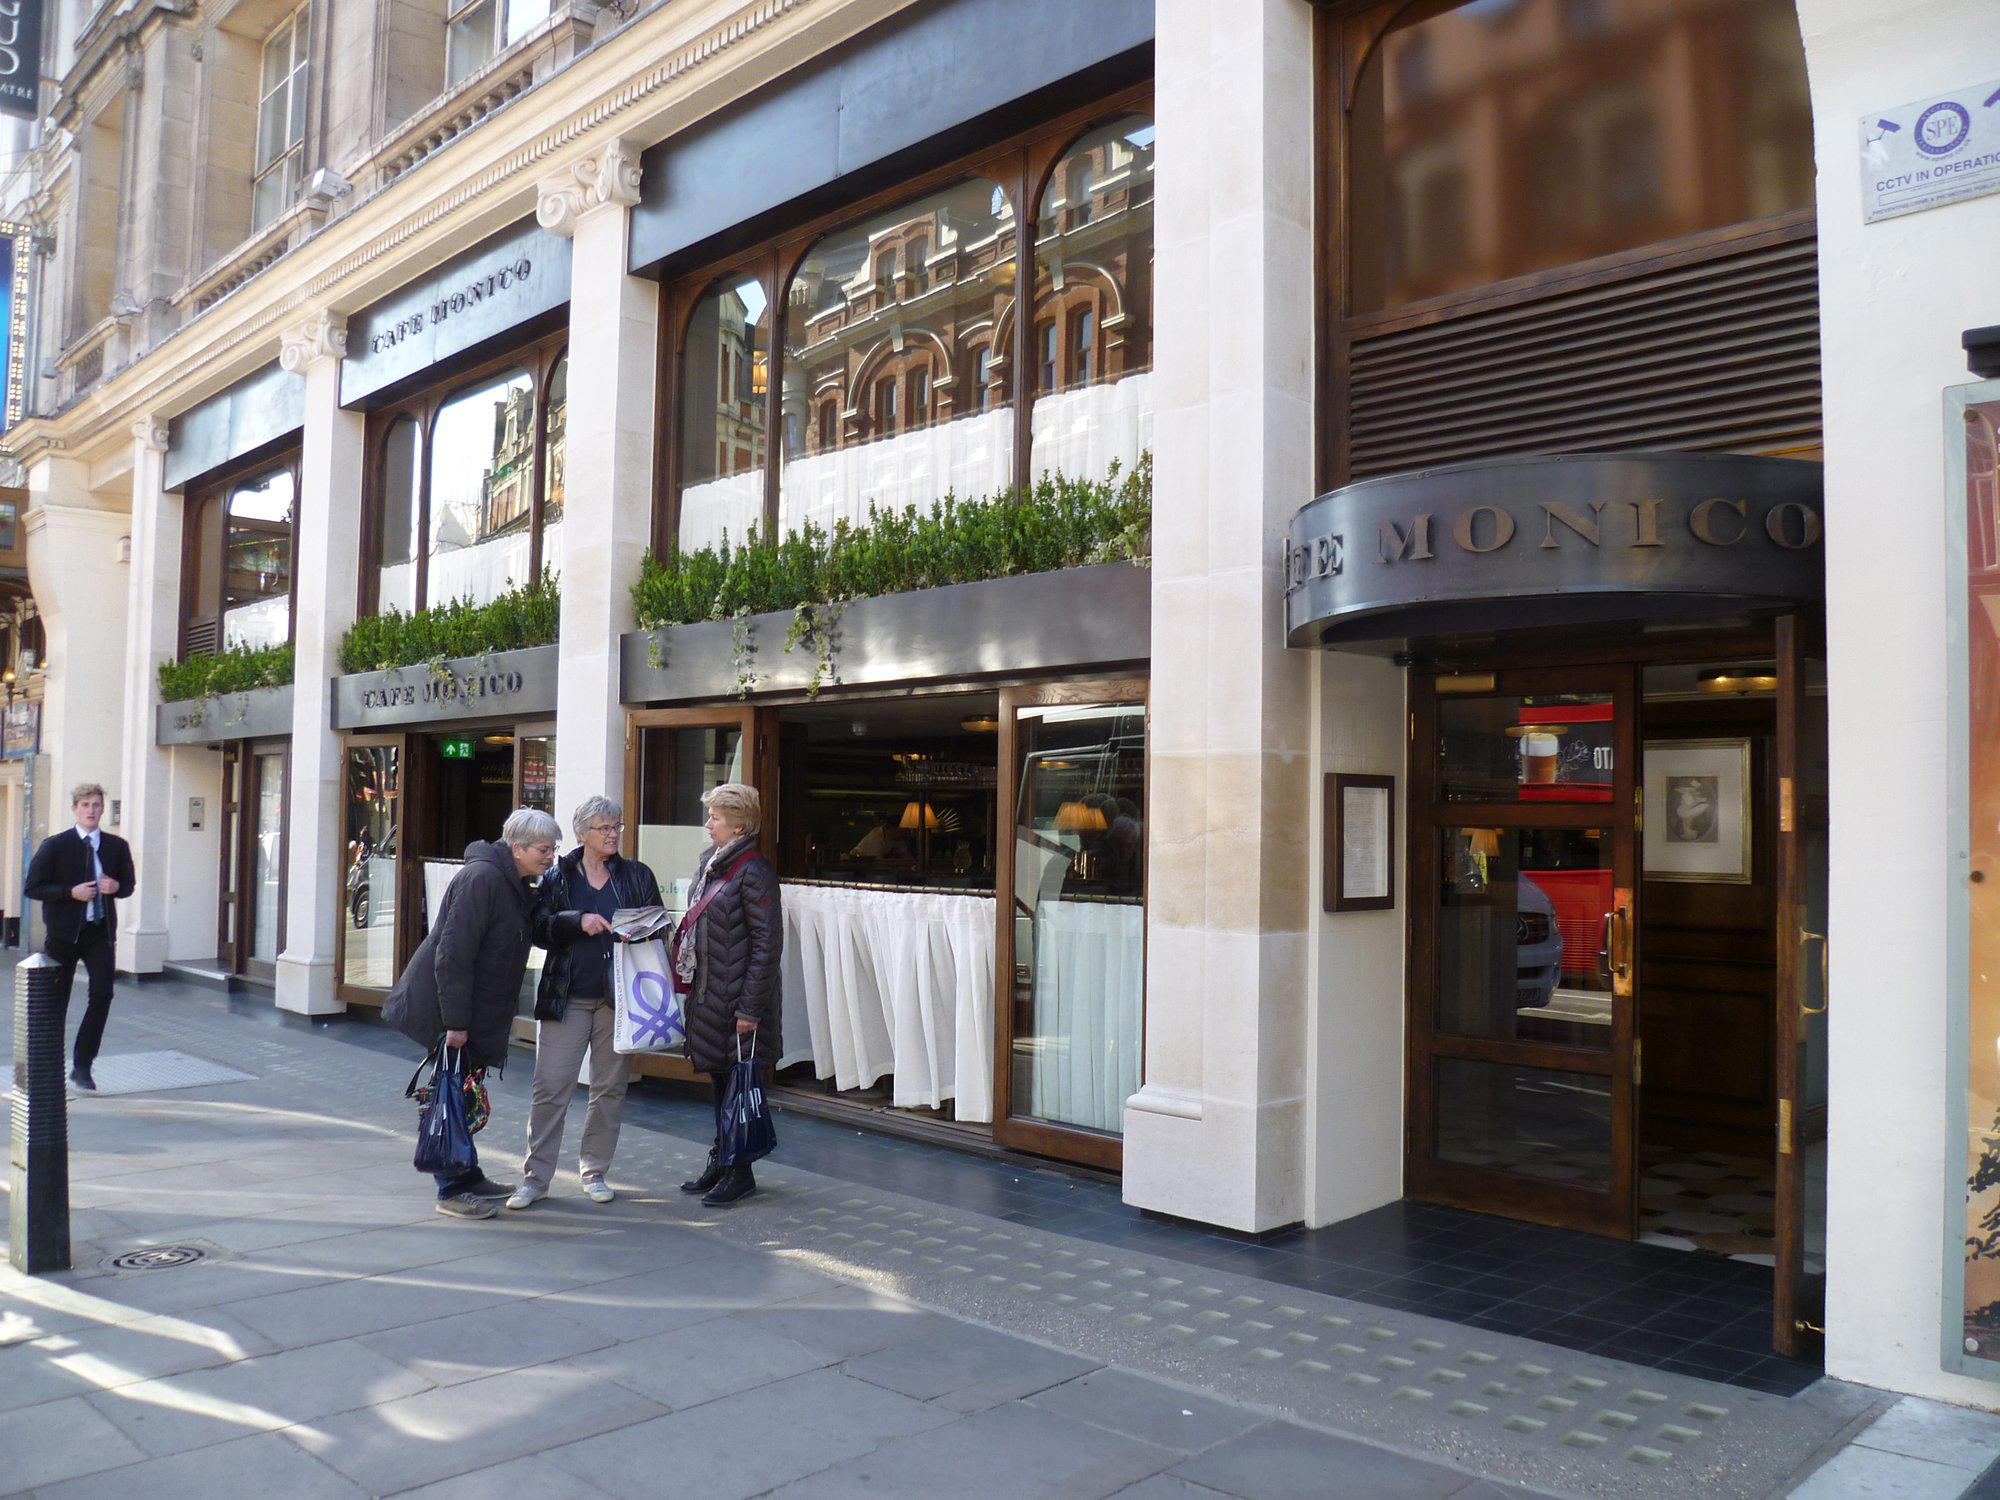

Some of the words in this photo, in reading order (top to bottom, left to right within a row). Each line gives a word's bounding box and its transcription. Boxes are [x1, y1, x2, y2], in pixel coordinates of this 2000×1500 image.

[1926, 115, 1958, 141] SPE
[1876, 174, 1912, 192] CCTV
[1916, 170, 1929, 182] IN
[373, 313, 423, 354] CAFE
[430, 258, 532, 325] MONICO
[1376, 498, 1819, 564] MONICO
[363, 685, 415, 709] CAFE
